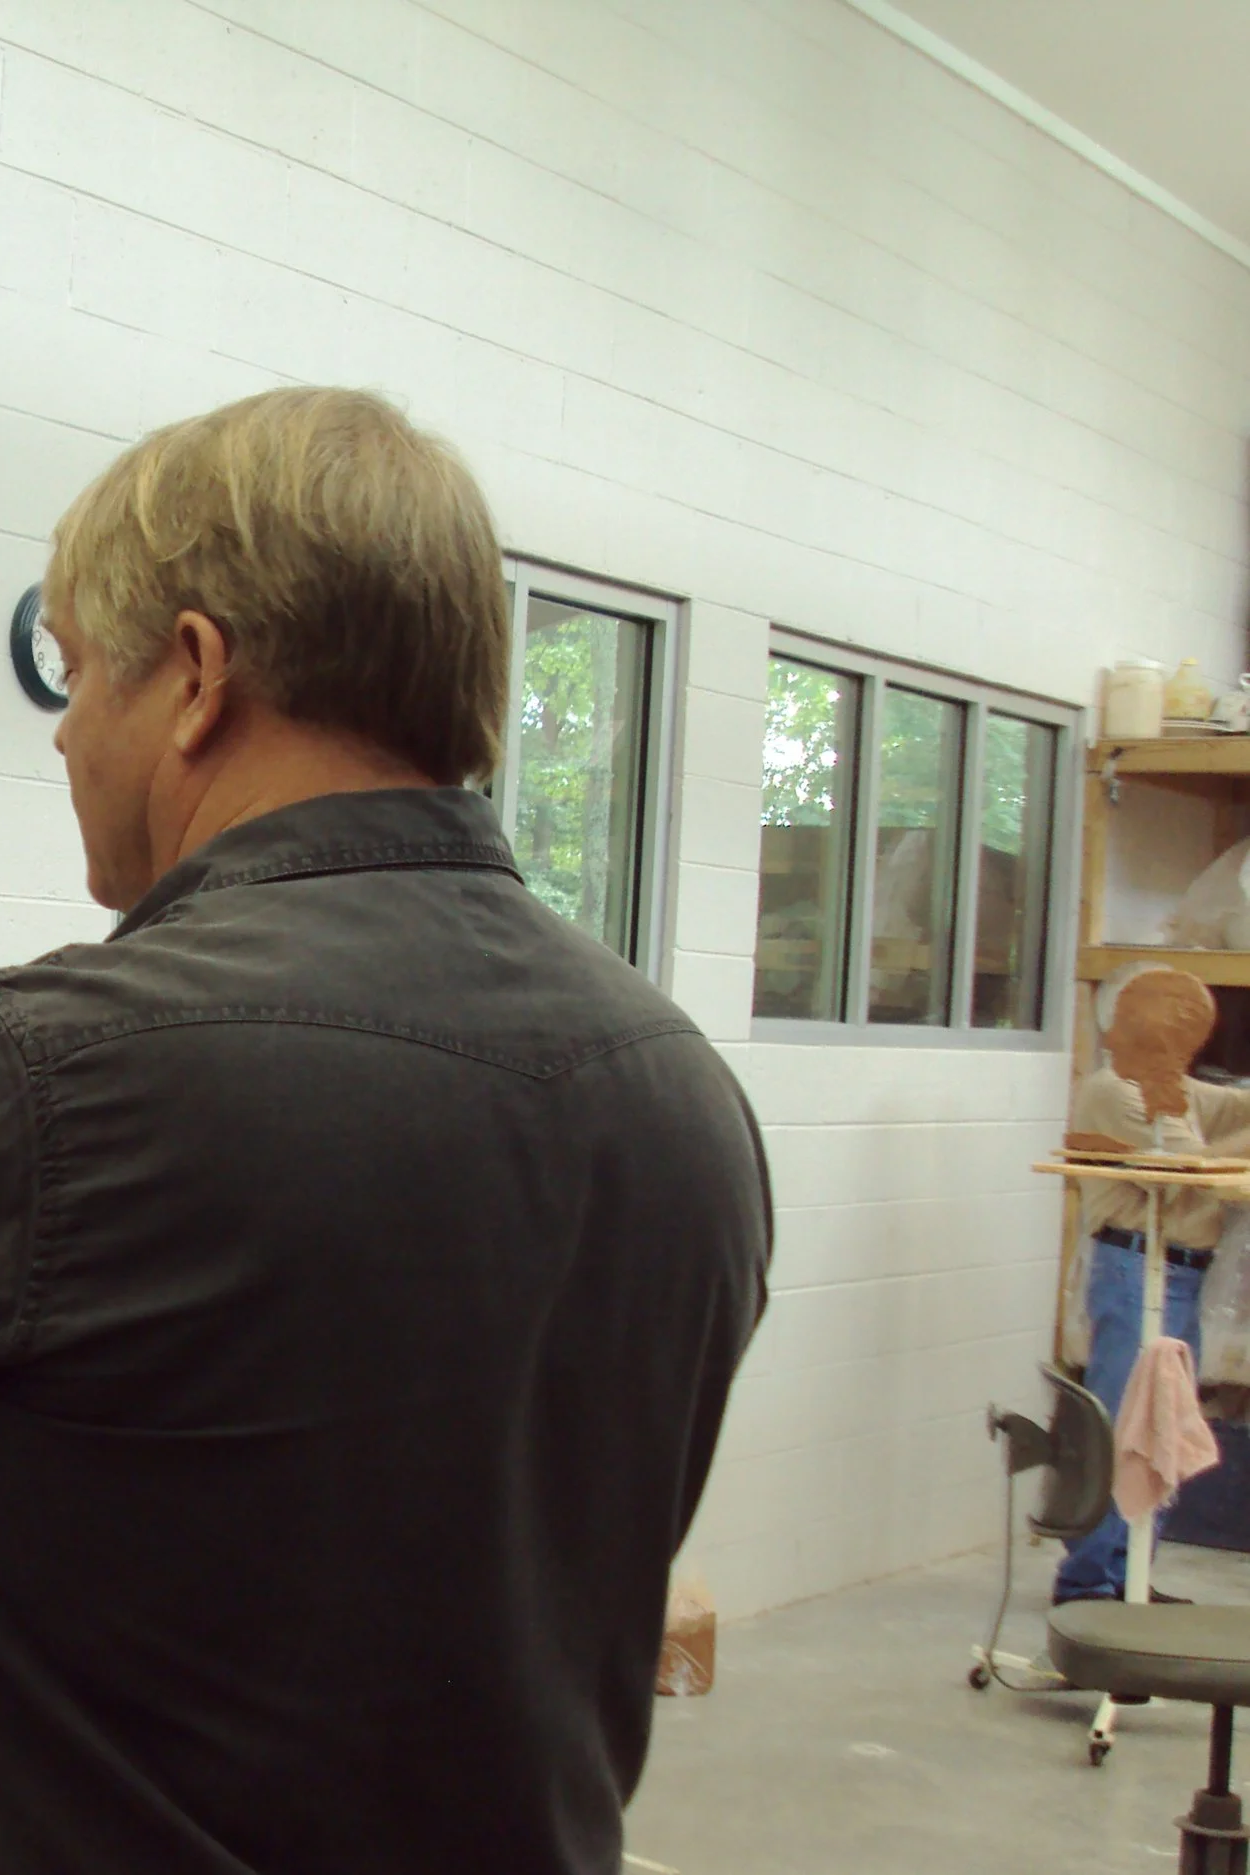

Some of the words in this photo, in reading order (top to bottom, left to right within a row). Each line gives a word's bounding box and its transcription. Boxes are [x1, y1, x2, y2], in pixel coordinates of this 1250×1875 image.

[33, 630, 42, 647] 9
[37, 651, 45, 670] 8
[48, 668, 55, 683] 7
